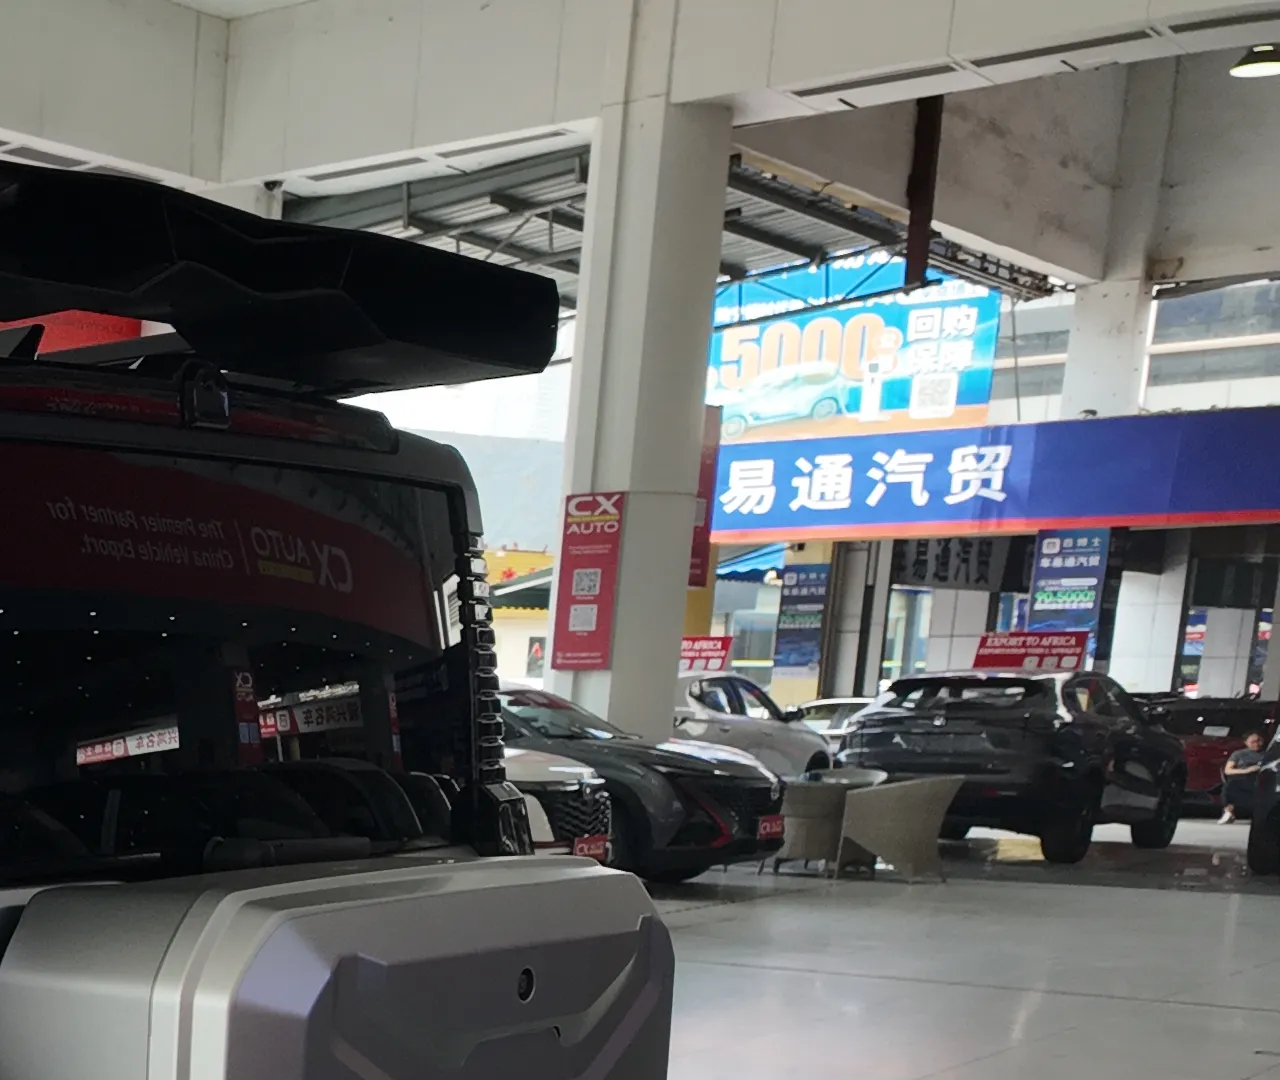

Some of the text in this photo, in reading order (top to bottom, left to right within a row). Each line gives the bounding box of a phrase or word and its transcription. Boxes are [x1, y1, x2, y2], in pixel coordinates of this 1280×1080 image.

[907, 305, 978, 343] 回购
[722, 313, 887, 391] 5000
[719, 444, 1014, 515] 易通汽贸
[566, 494, 622, 517] CX
[566, 521, 619, 536] AUTO
